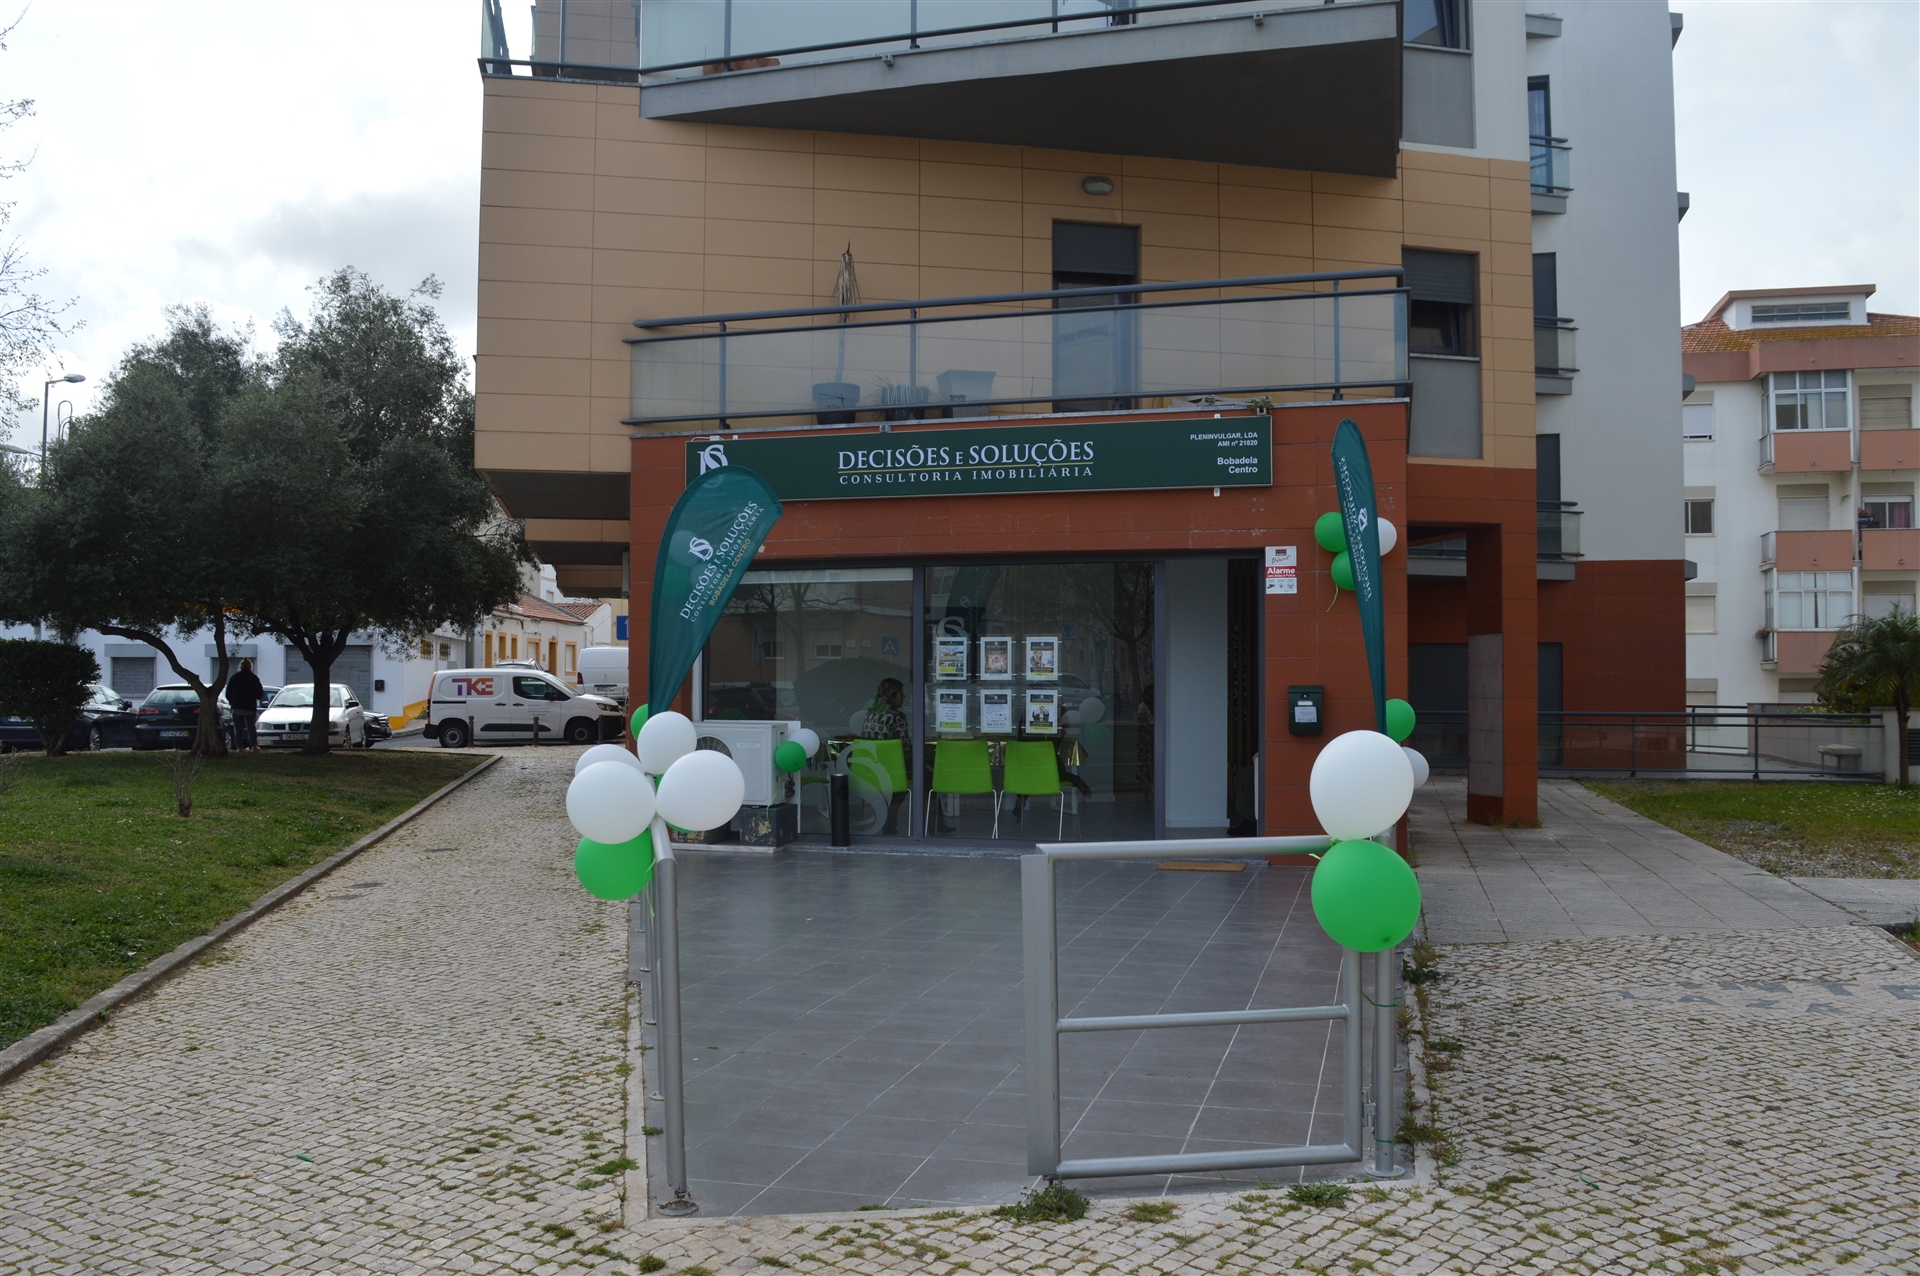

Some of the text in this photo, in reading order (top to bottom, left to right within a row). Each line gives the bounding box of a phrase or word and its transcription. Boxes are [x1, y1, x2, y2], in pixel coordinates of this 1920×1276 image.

[1190, 432, 1243, 440] PLENINVULGAR,
[838, 439, 1094, 470] DECISÕES E SOLUÇÕES
[1217, 456, 1258, 465] Bobadela
[840, 465, 1092, 485] CONSULTORIA IMOBILIÁRIA
[1228, 466, 1258, 474] Centro
[679, 500, 759, 620] DECISÕES E SOLUÇÕES
[690, 507, 765, 623] CONSULTORIA IMOBILIÁRIA
[708, 538, 751, 606] BOBADELA CENTRO
[452, 678, 493, 696] TKE
